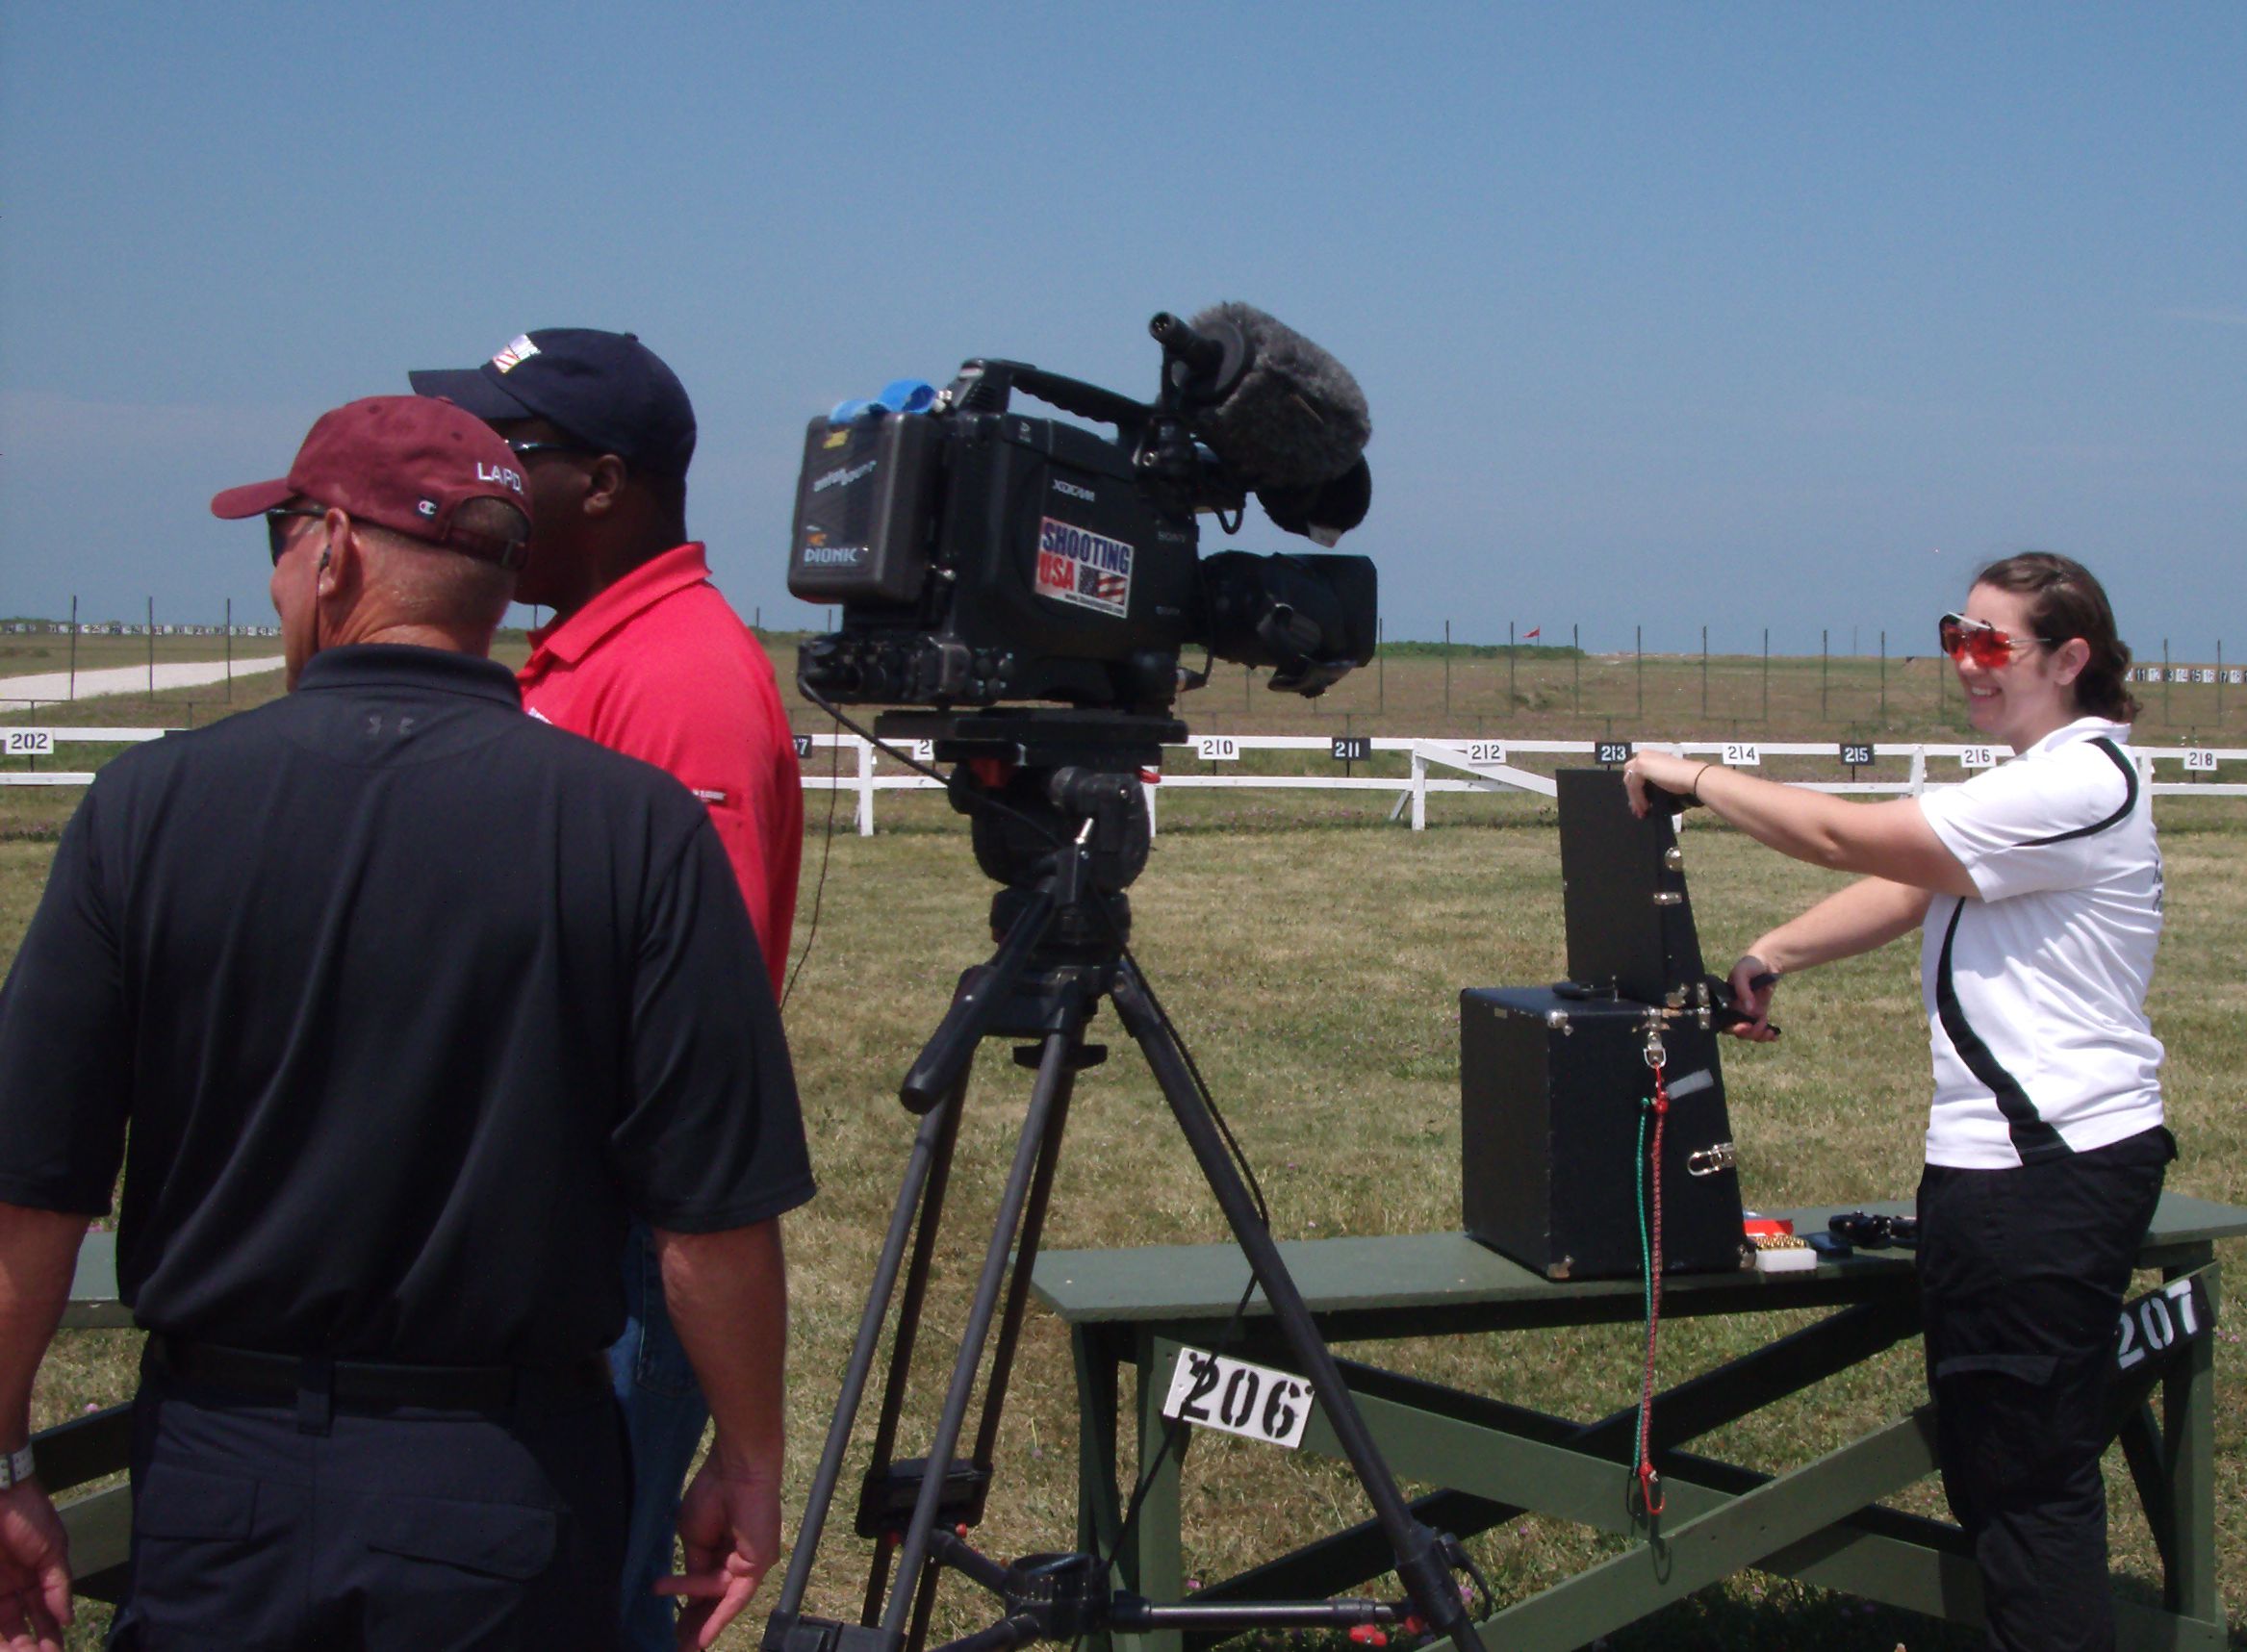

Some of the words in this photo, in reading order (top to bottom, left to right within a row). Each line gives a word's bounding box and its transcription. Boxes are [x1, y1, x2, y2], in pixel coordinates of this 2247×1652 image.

[804, 547, 858, 563] DIONIC
[1042, 521, 1131, 575] SHOOTING
[1038, 553, 1075, 592] USA
[11, 733, 48, 750] 202
[1203, 740, 1234, 755] 210
[1335, 742, 1360, 757] 211
[1471, 745, 1500, 760] 212
[1601, 746, 1626, 761] 213
[1728, 746, 1755, 760] 214
[1845, 748, 1868, 762] 215
[1965, 750, 1990, 763] 216
[2189, 752, 2212, 766] 218
[2118, 1279, 2198, 1369] 207
[1178, 1359, 1300, 1438] 206
